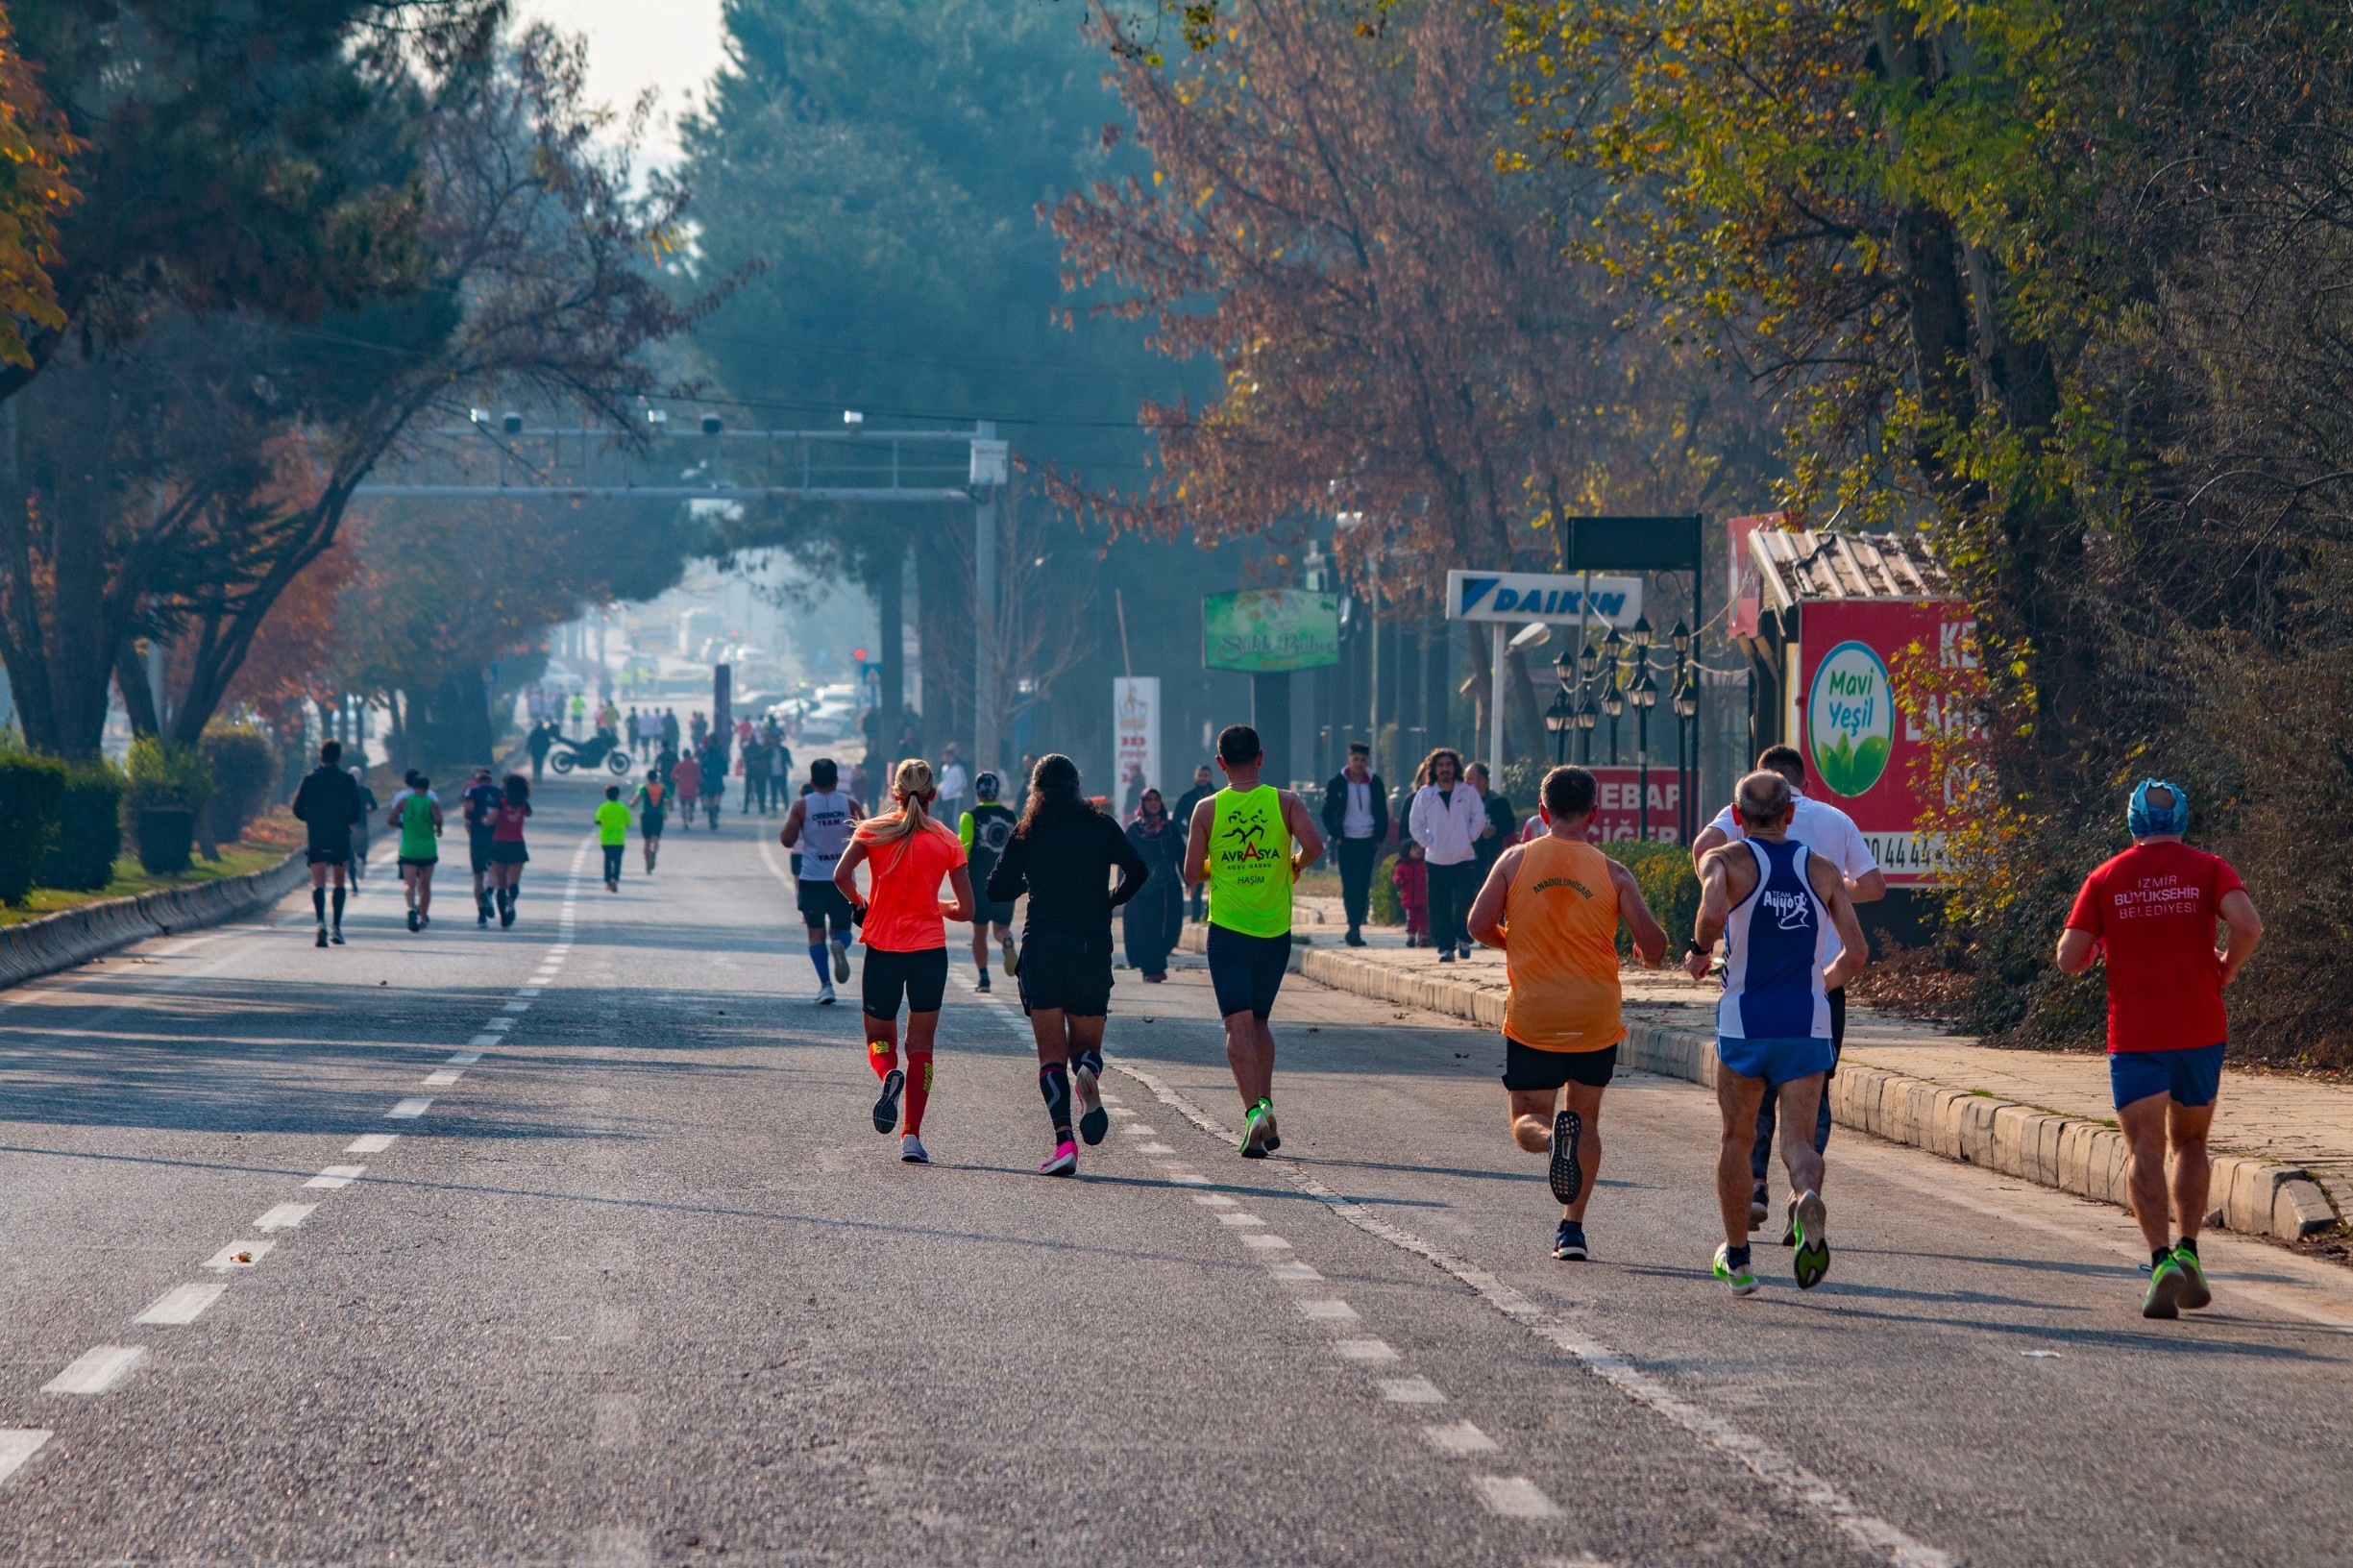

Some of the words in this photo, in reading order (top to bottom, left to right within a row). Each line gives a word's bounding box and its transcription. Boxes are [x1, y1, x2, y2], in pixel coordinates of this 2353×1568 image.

[1492, 588, 1627, 616] DAIKIN
[1829, 667, 1874, 697] Mavi
[1829, 696, 1874, 737] Yeşil
[1596, 783, 1679, 810] EBAP
[1221, 840, 1280, 863] AVRASYA
[1238, 874, 1265, 886] HAŞİM
[1772, 890, 1792, 898] TEAM
[2115, 885, 2199, 906] BÜYÜKŞEHİR
